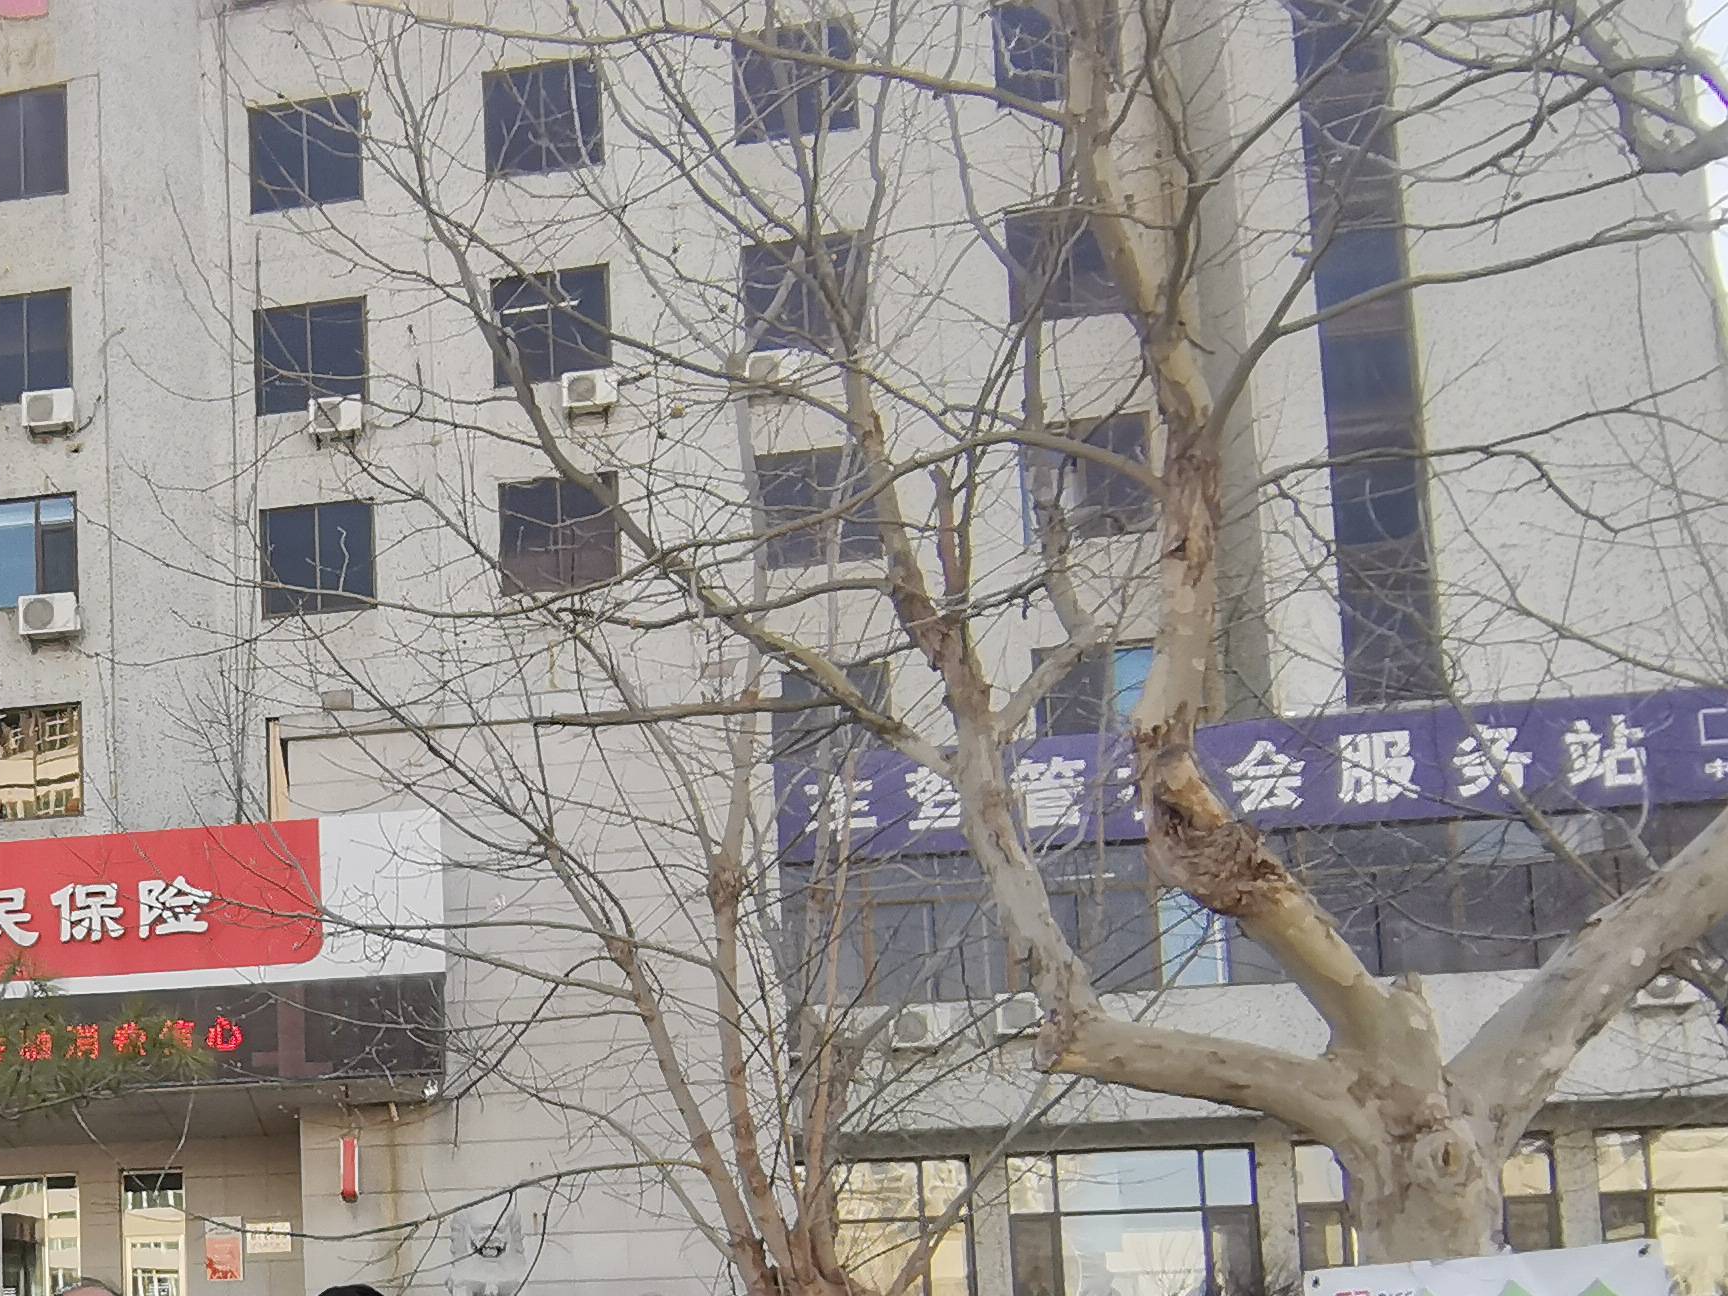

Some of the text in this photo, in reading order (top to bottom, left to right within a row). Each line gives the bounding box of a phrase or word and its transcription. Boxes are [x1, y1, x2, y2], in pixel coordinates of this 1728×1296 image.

[803, 714, 1648, 841] 车驾管会服务站
